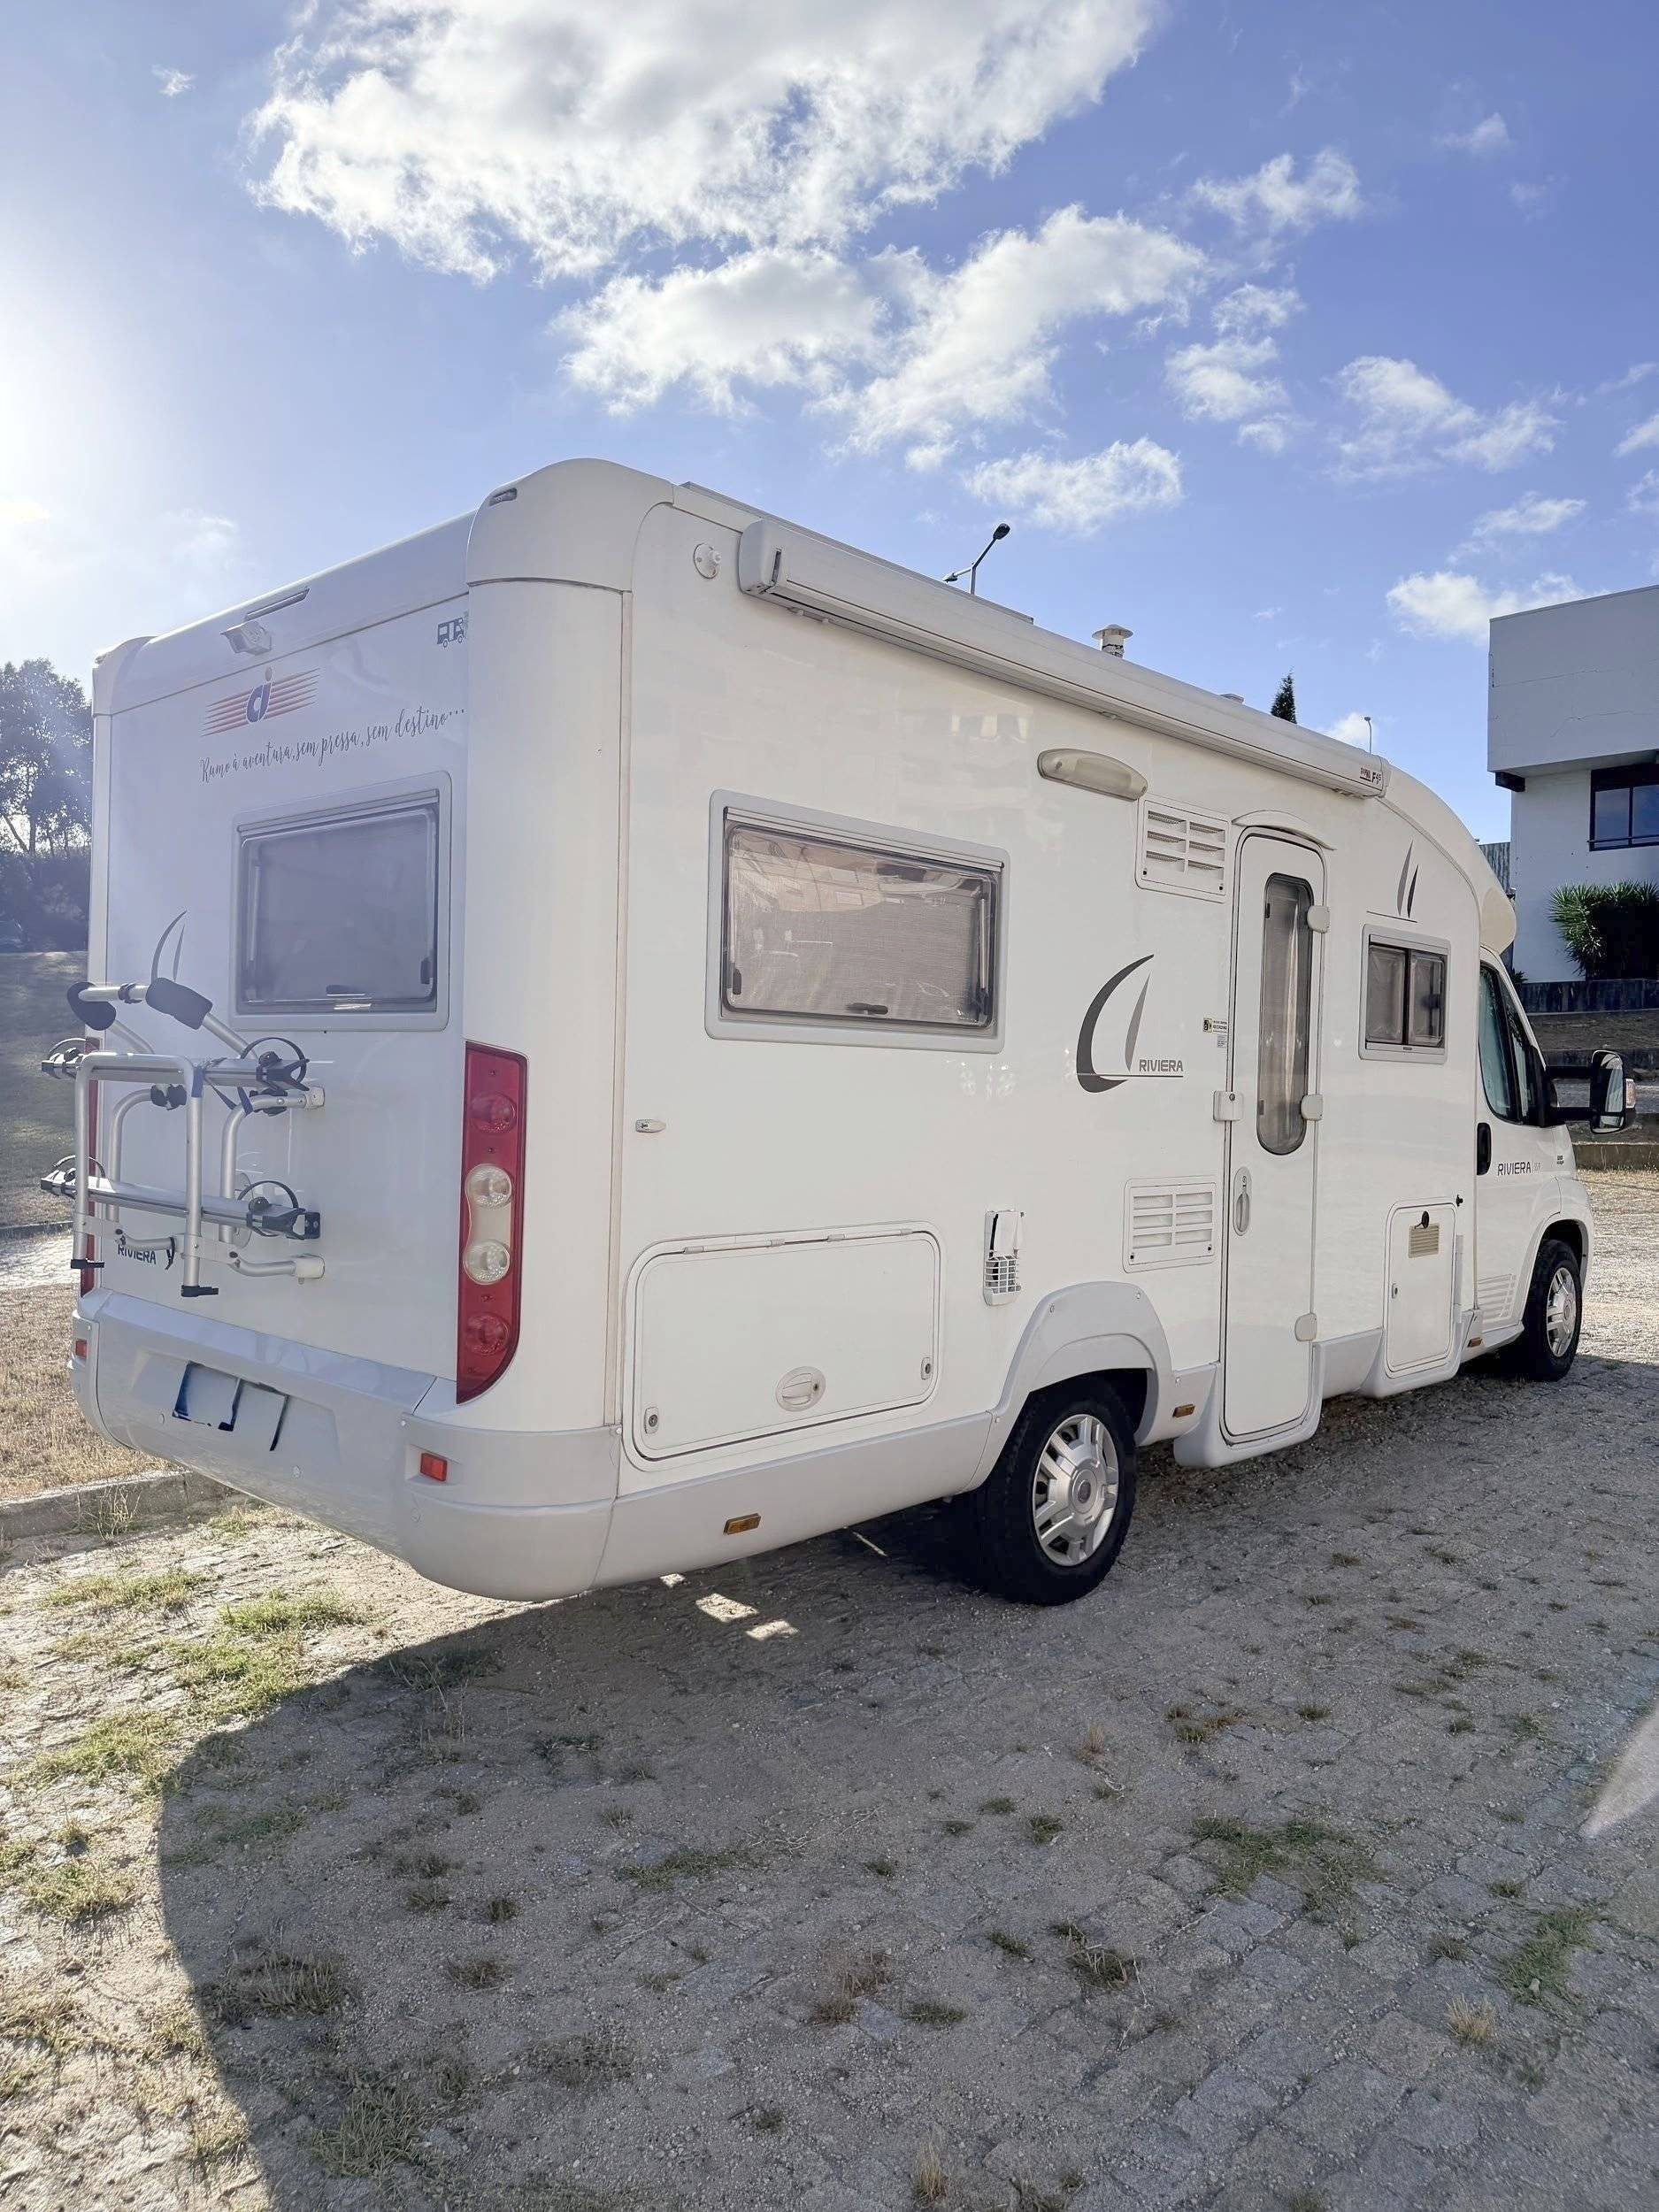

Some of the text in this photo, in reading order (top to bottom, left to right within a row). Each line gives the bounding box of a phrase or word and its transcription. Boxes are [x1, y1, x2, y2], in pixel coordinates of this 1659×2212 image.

[201, 757, 230, 783] Rumo
[233, 750, 240, 771] à
[319, 732, 364, 767] pressa,
[365, 726, 393, 747] sem
[1139, 1059, 1184, 1072] RIVIERA
[1497, 1161, 1532, 1177] RIVIERA
[118, 1243, 157, 1265] RIVIERA
